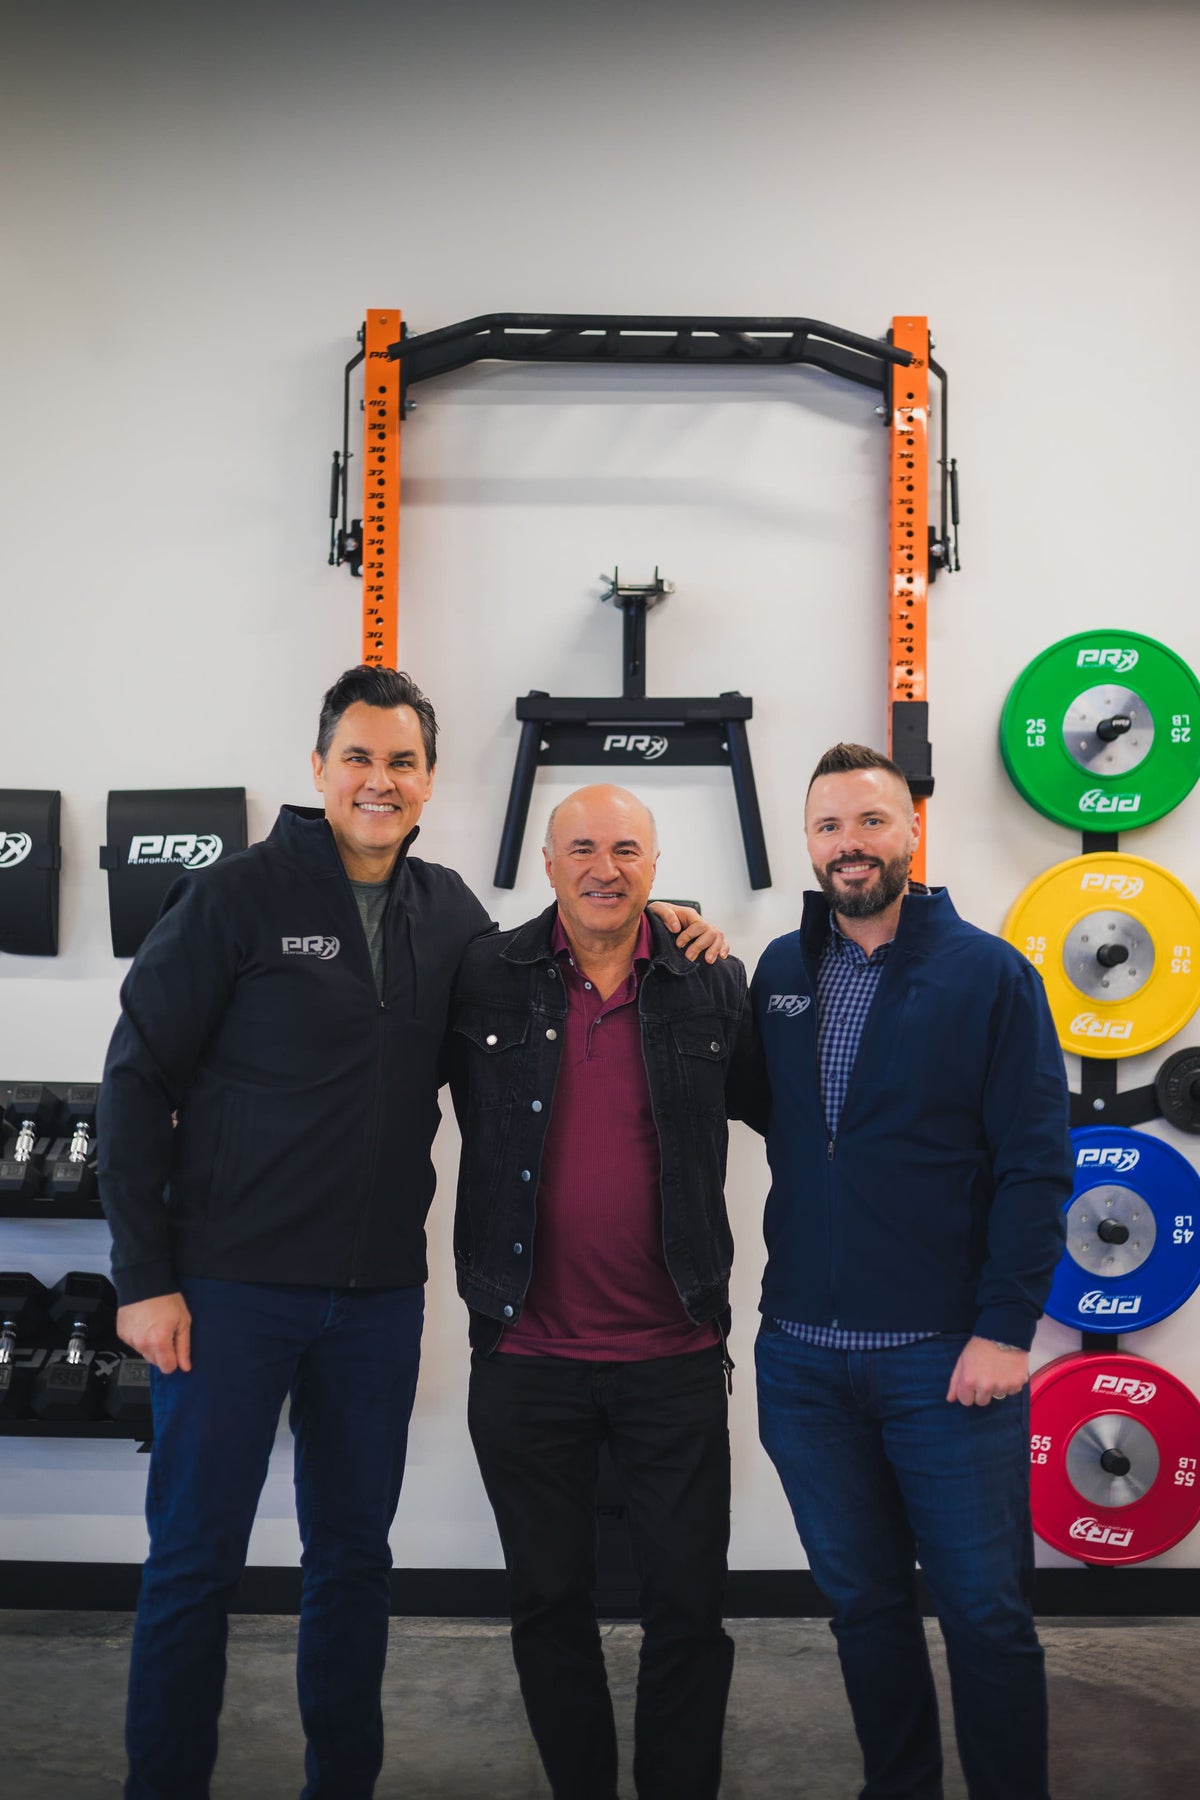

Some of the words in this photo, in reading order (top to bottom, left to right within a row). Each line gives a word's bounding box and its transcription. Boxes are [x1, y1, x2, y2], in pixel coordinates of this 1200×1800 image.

[1026, 718, 1047, 735] 25
[1172, 714, 1190, 726] LB
[1027, 735, 1045, 747] LB
[1170, 727, 1191, 743] 25
[127, 857, 190, 865] PERFORMANCE
[1026, 936, 1047, 951] 35
[1173, 945, 1191, 957] LB
[1171, 959, 1191, 974] 35
[1174, 1215, 1192, 1227] LB
[1173, 1229, 1194, 1244] 45
[1030, 1434, 1052, 1451] 55
[1030, 1452, 1047, 1465] LB
[1178, 1457, 1196, 1469] LB
[1174, 1470, 1196, 1487] 55
